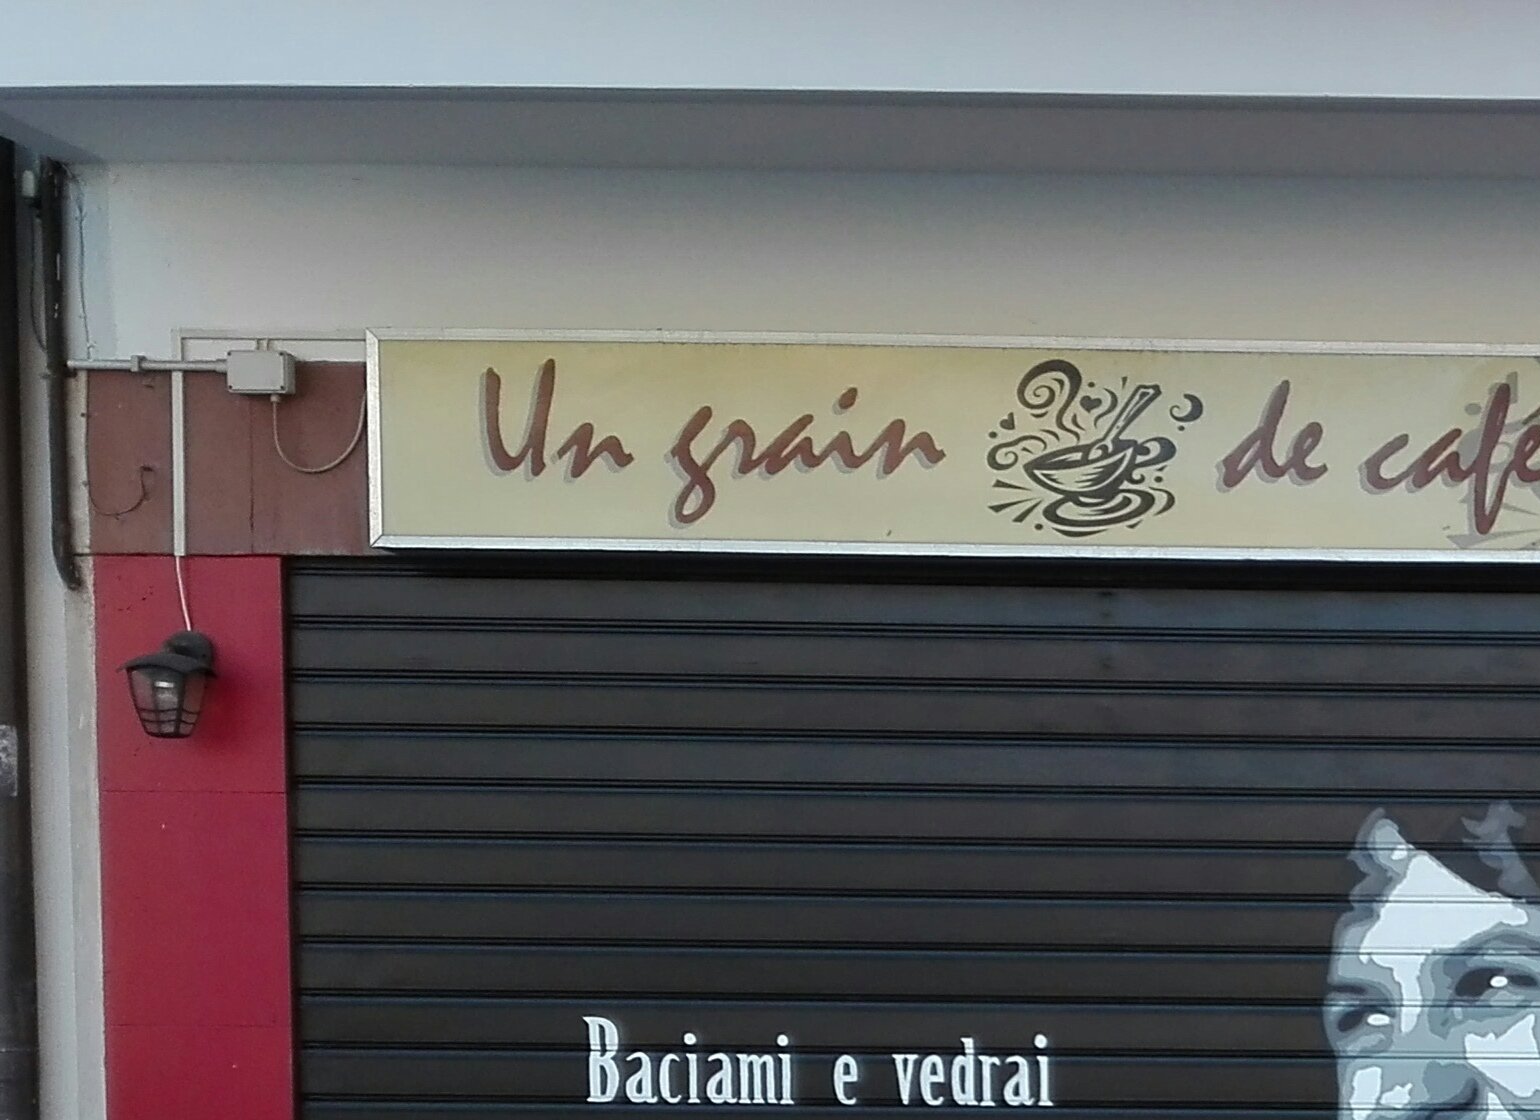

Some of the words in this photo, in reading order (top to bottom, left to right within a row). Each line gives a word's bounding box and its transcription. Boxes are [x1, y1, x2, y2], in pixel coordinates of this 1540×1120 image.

[480, 358, 634, 478] Un
[664, 386, 946, 530] grain
[1216, 379, 1329, 493] de
[582, 1015, 796, 1106] Baciami
[832, 1053, 860, 1106] e
[891, 1032, 1055, 1107] vedrai
